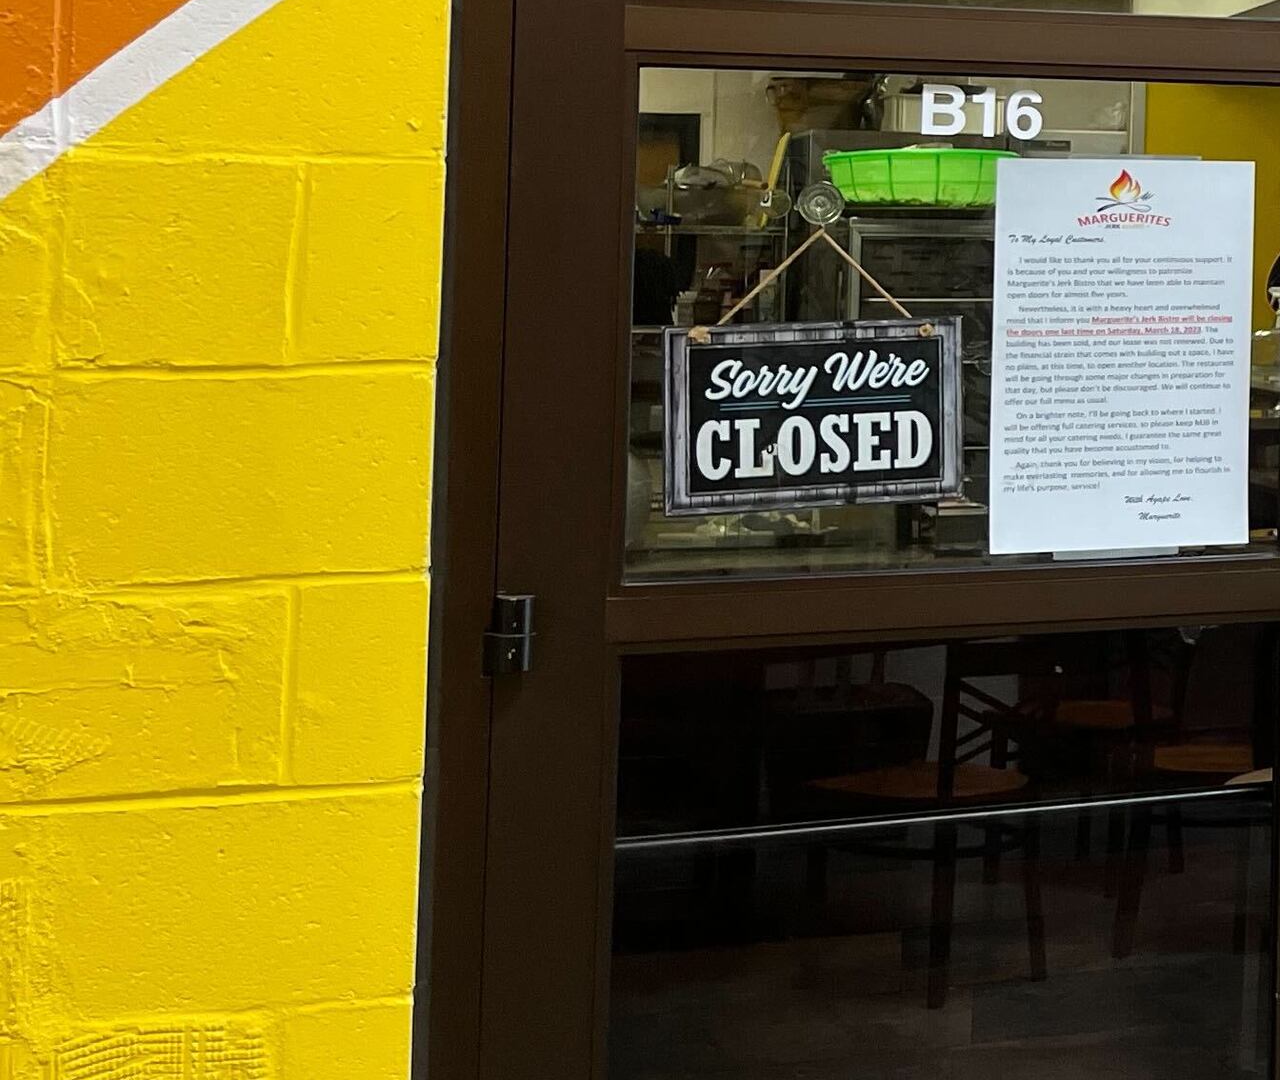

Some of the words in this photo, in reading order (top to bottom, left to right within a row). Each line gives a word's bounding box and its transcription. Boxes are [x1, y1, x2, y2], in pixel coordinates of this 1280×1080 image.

[920, 83, 1044, 140] B16
[1077, 212, 1172, 228] MARGUERITES
[705, 358, 820, 411] Sorry
[824, 351, 931, 393] We're
[696, 410, 934, 482] CLOSED
